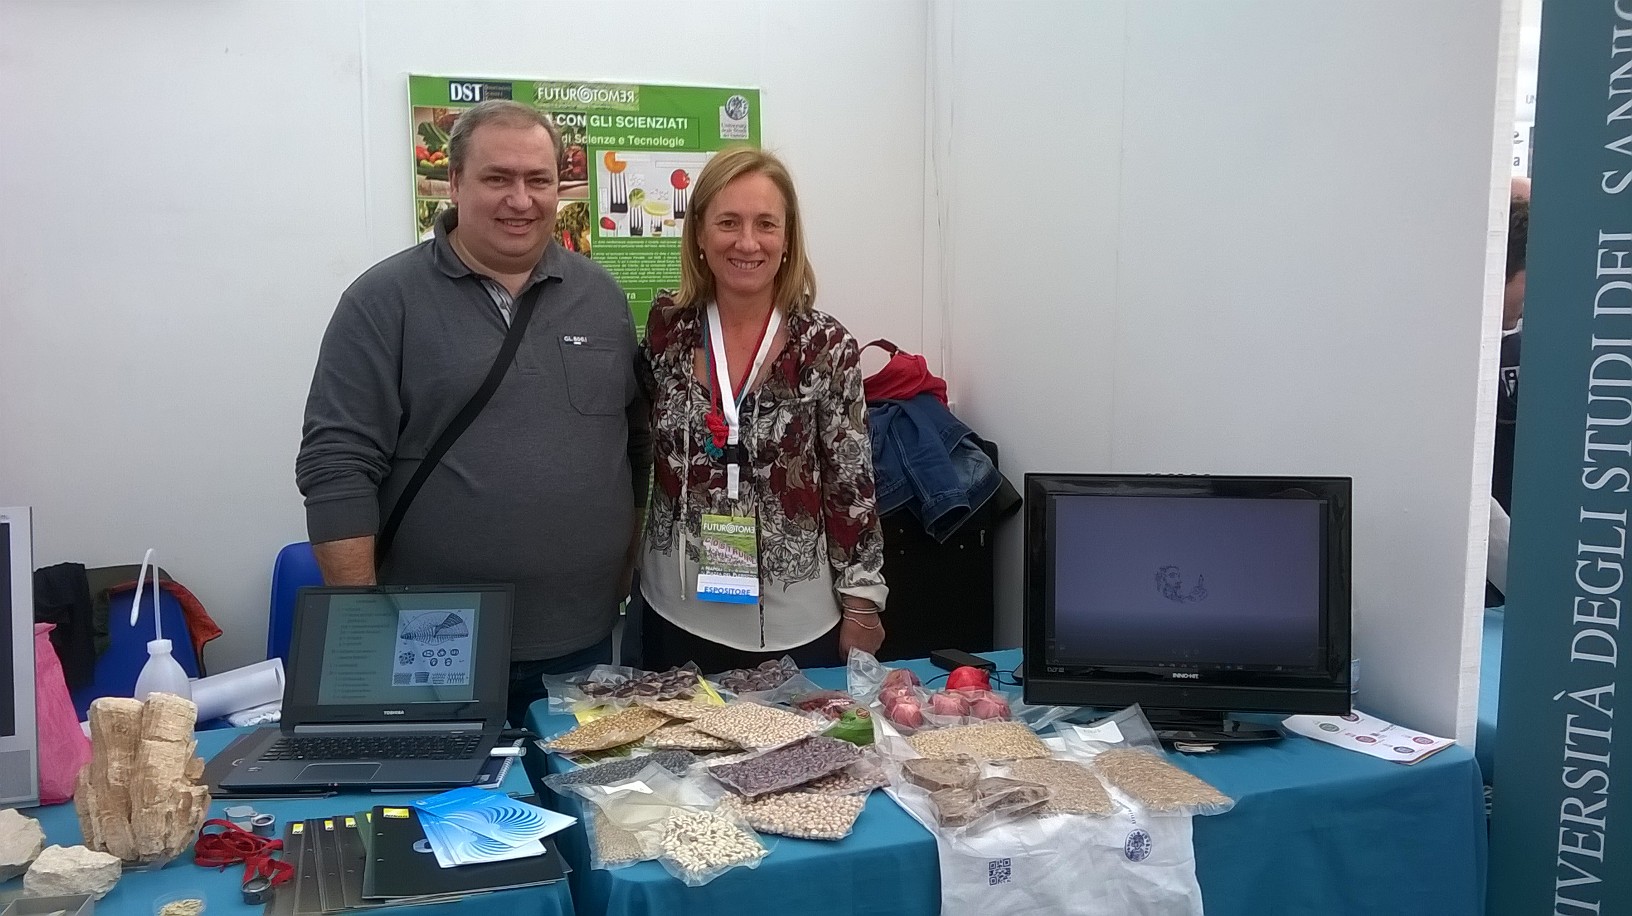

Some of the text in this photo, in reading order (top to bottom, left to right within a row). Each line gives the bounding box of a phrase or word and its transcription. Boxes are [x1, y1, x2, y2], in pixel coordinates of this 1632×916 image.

[450, 82, 482, 101] DST
[556, 113, 587, 127] CON
[590, 115, 612, 128] GLI
[615, 115, 688, 129] SCIENZIATI
[561, 133, 685, 148] di Scienze e Tecnologie
[1581, 332, 1632, 493] STUDI
[704, 586, 751, 596] ESPOSITORE
[1570, 505, 1628, 668] DEGLI
[1552, 681, 1616, 916] IVERSITÀ
